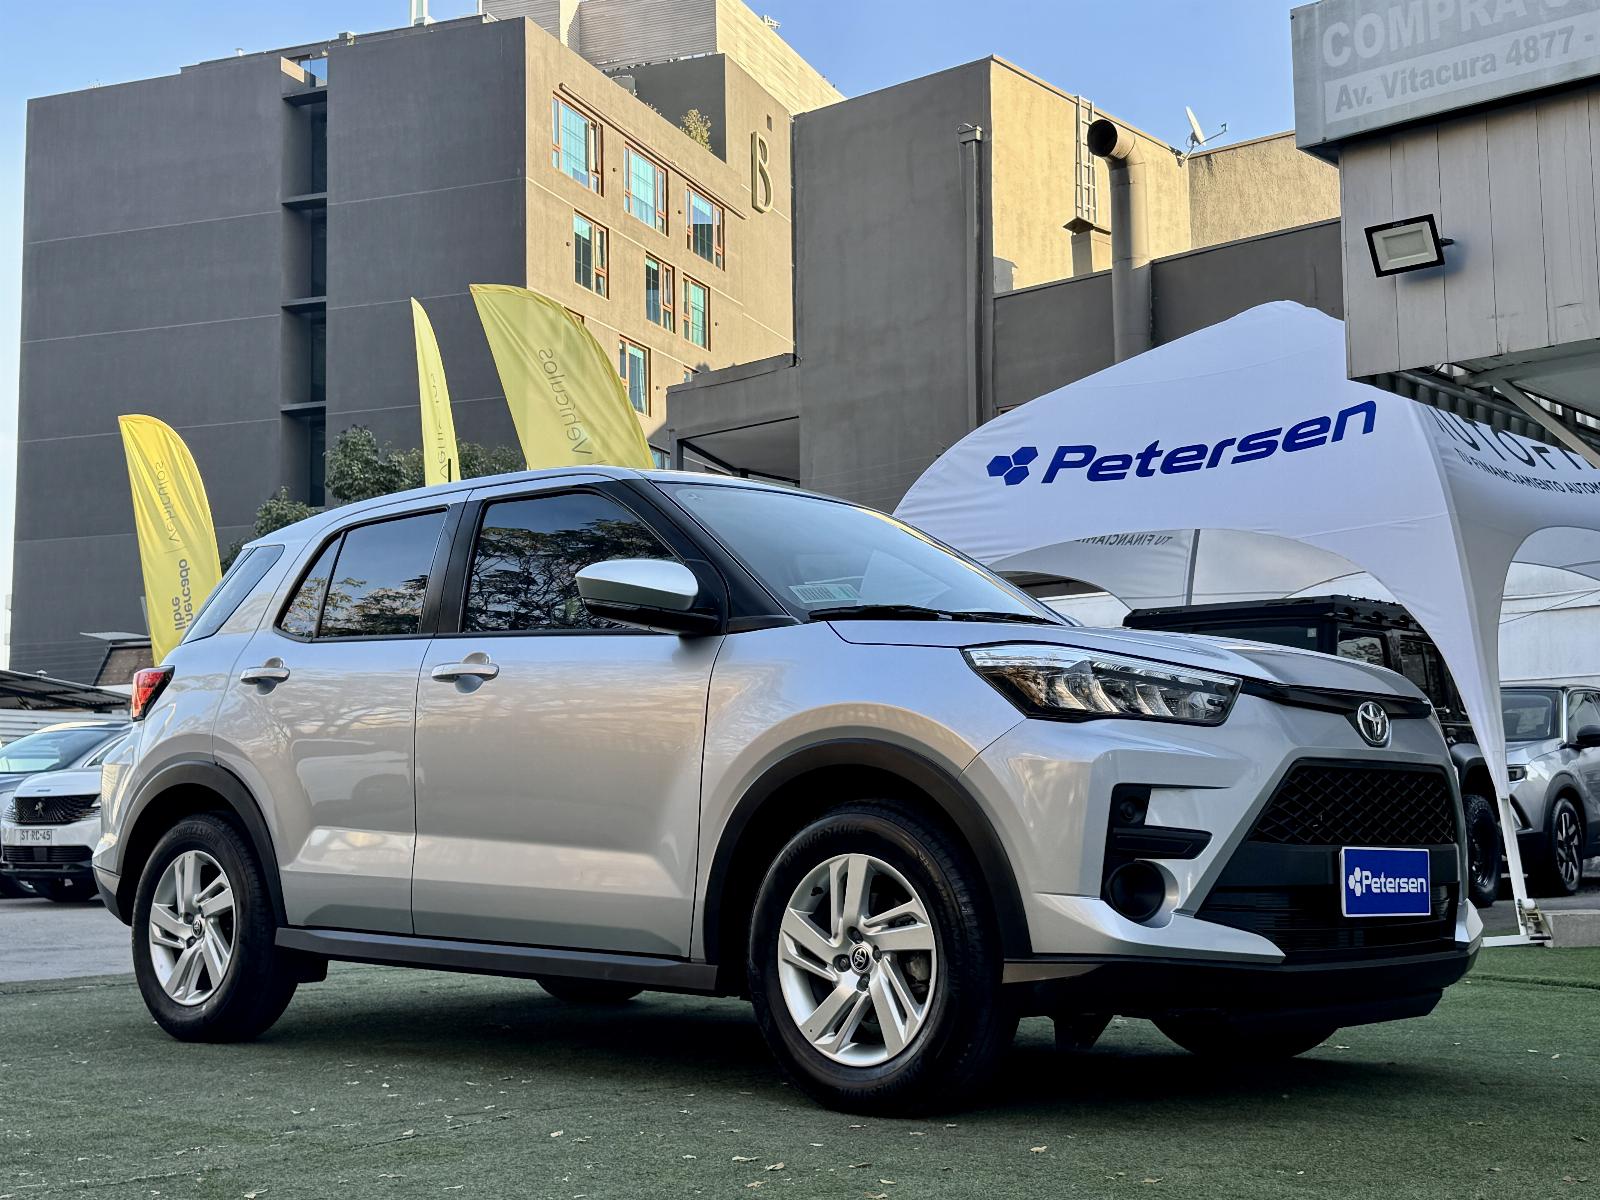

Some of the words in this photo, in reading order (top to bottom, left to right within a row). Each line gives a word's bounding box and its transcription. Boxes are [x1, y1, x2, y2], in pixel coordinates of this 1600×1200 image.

[1334, 84, 1373, 114] Av.
[1380, 53, 1497, 100] Vitacura
[1505, 25, 1575, 67] 4877
[1041, 400, 1377, 484] Petersen
[1468, 455, 1567, 494] FINANCIAMIENTO
[1563, 481, 1600, 495] AUTOM
[1362, 870, 1427, 893] Petersen
